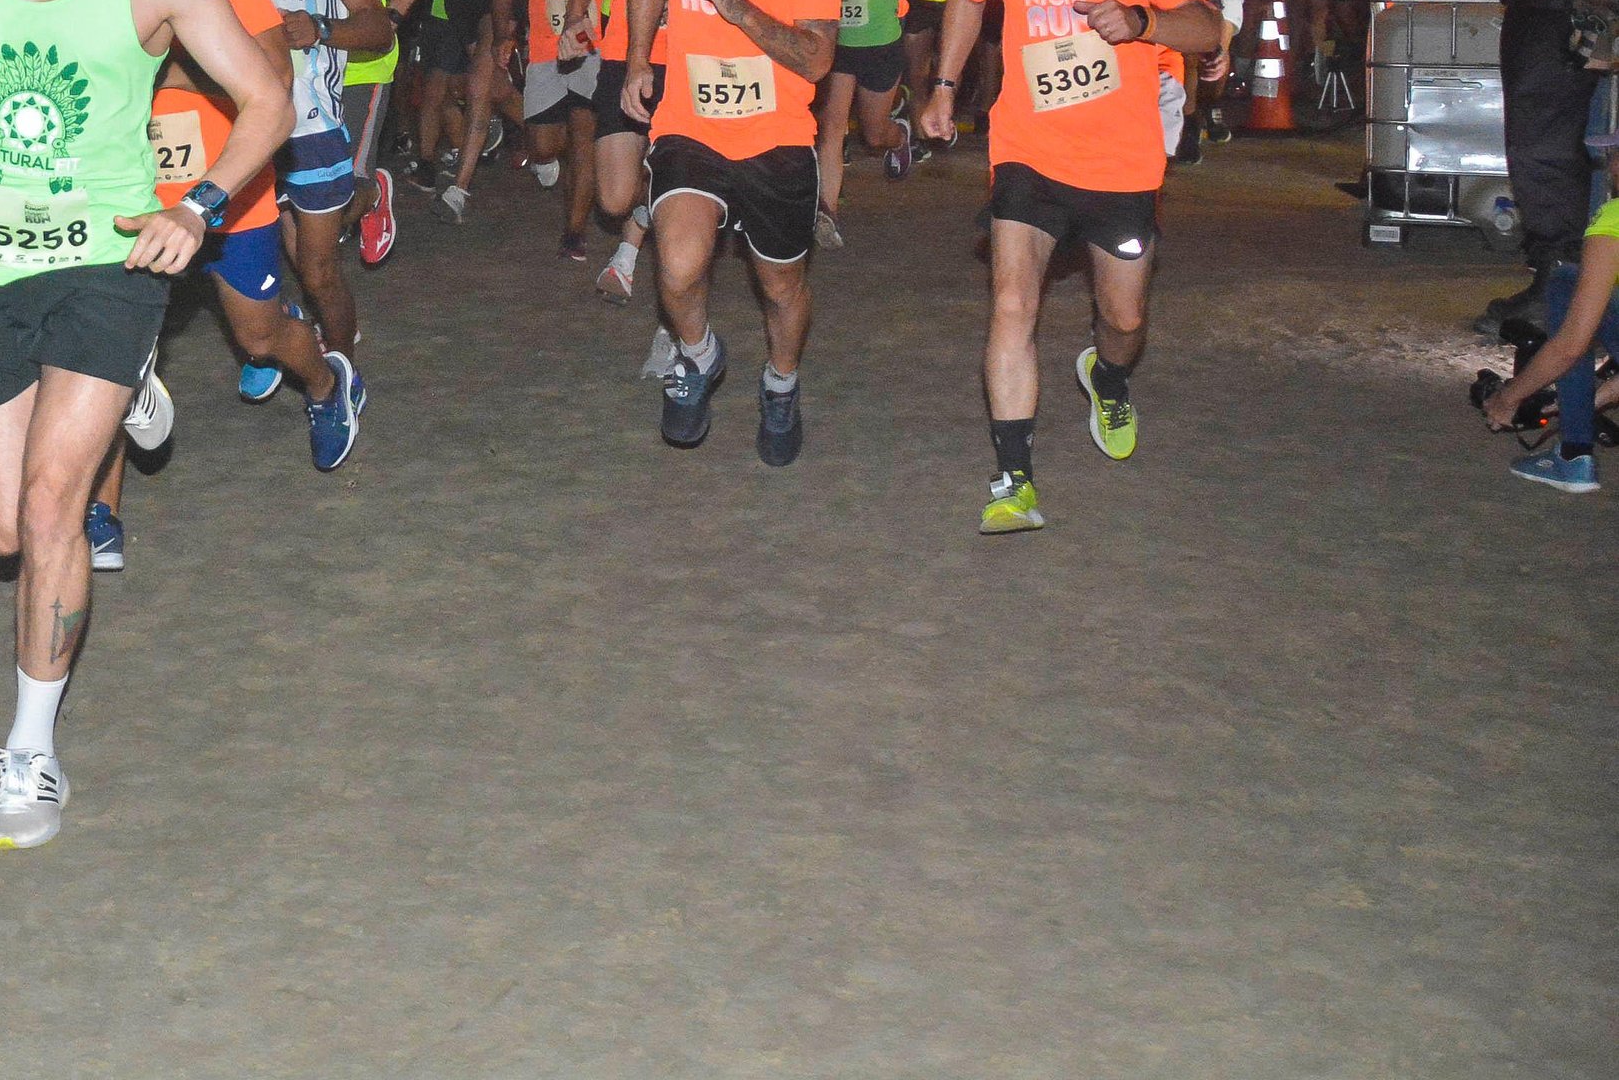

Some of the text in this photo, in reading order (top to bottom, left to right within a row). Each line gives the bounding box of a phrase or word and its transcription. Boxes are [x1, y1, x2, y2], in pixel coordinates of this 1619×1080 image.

[840, 5, 862, 18] 52
[1037, 59, 1110, 96] 5302
[698, 81, 761, 105] 5571
[157, 143, 192, 169] 27
